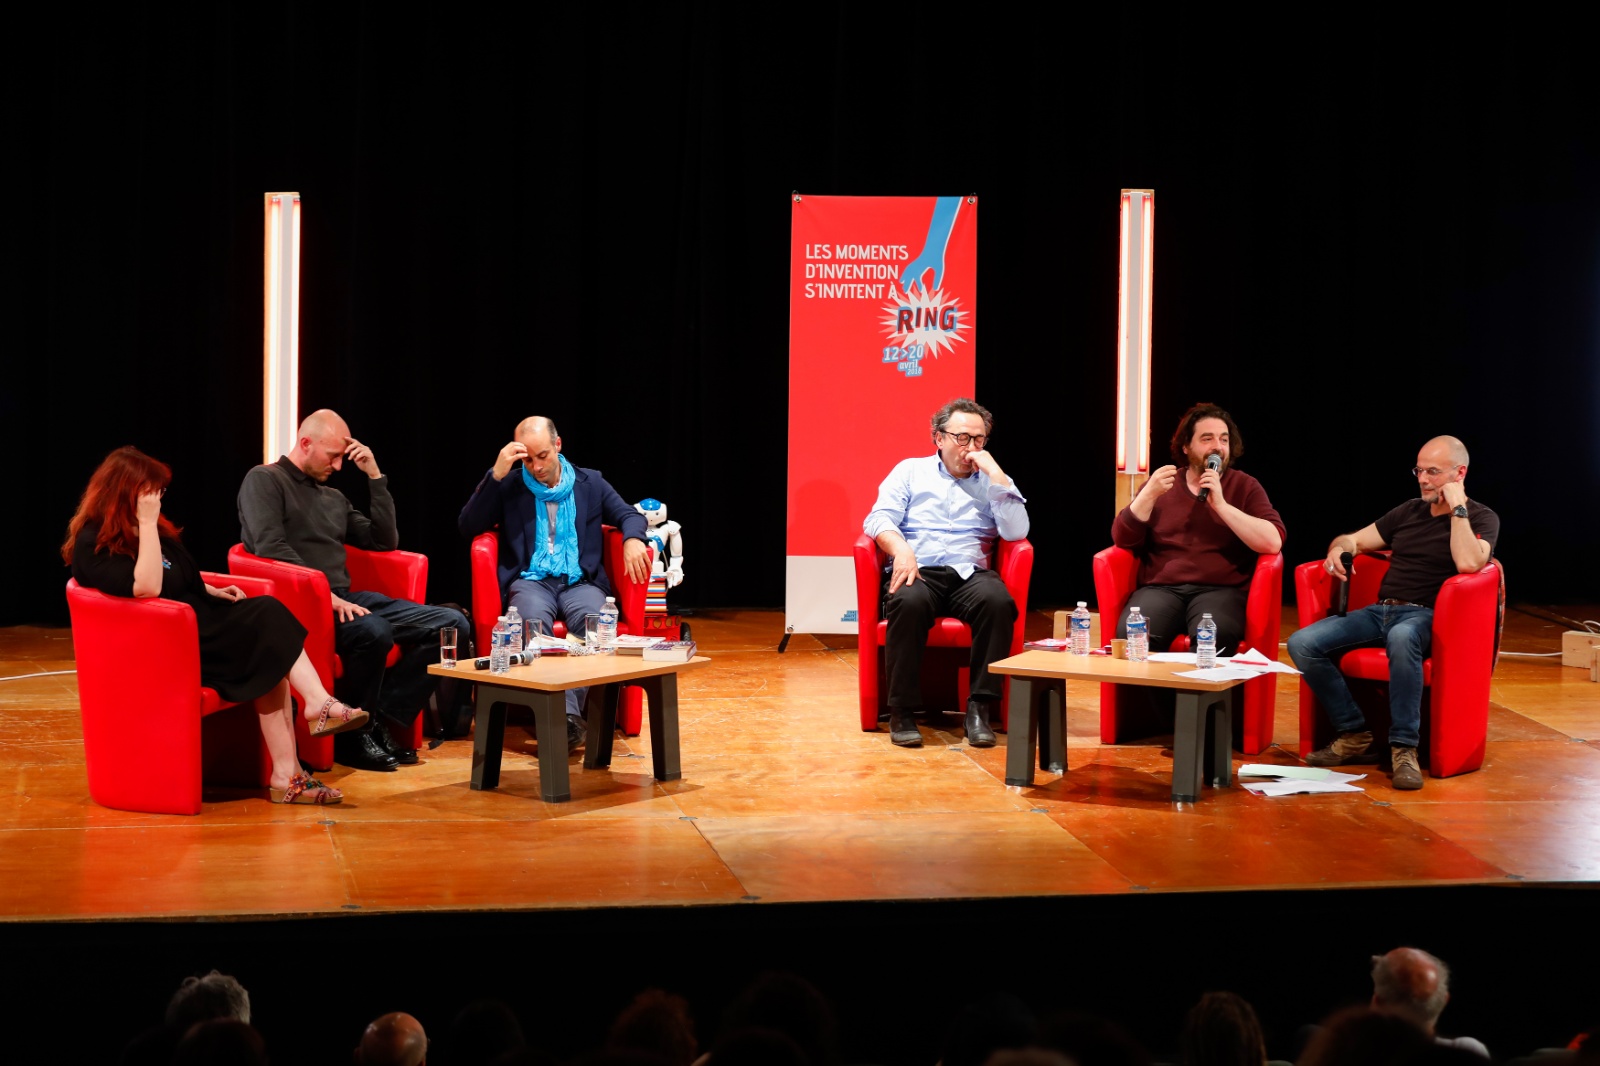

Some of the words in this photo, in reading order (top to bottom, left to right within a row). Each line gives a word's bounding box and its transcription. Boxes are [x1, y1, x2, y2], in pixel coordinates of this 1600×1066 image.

[805, 244, 832, 260] LES
[835, 244, 909, 260] MOMENTS
[805, 263, 899, 280] D'INVENTION
[804, 282, 885, 299] S'INVITENT
[887, 281, 898, 299] À
[897, 305, 958, 334] RING
[899, 359, 918, 370] avril
[907, 367, 922, 375] 2018
